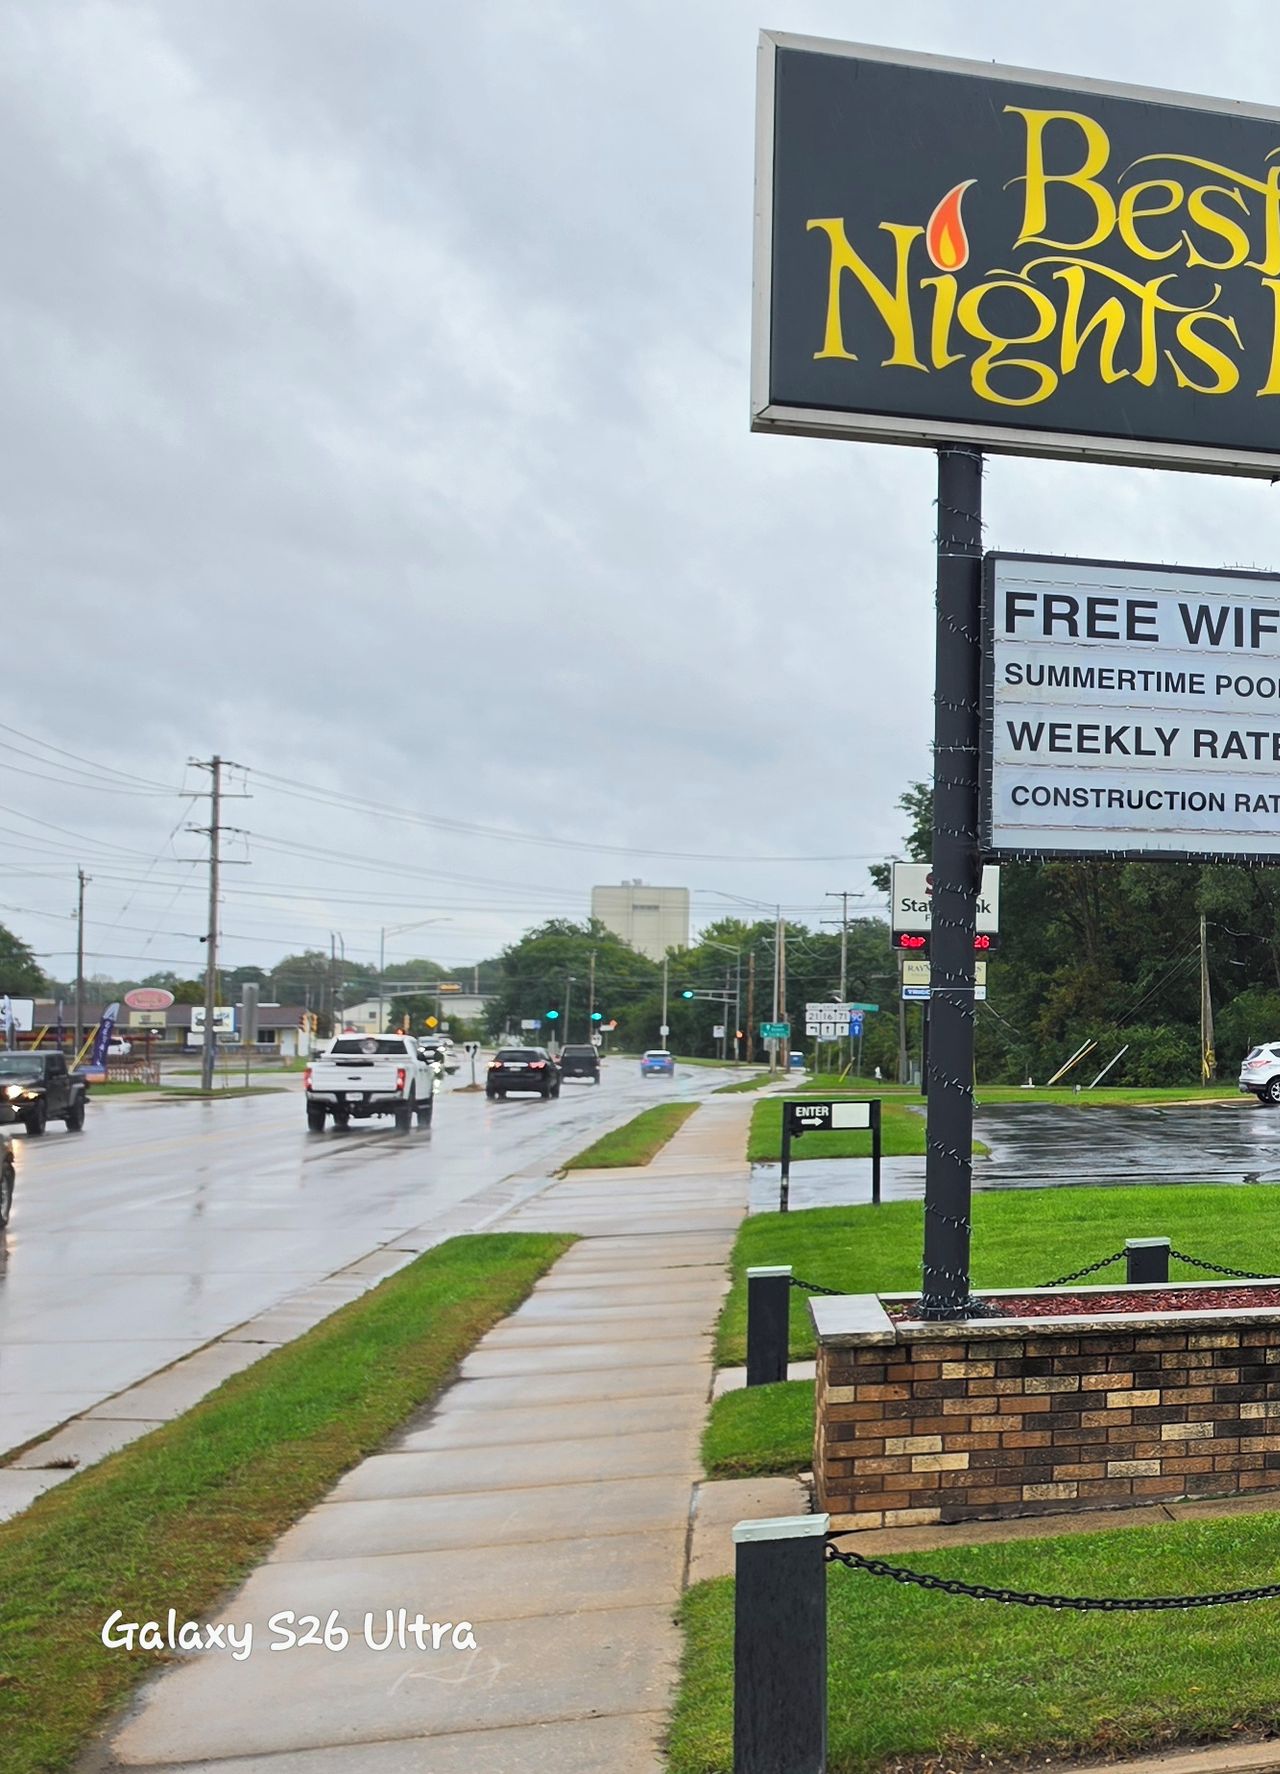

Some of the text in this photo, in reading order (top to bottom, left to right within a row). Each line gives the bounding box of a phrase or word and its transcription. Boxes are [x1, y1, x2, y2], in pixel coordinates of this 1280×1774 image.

[806, 215, 1245, 407] Nights
[1004, 590, 1160, 643] FREE
[1004, 662, 1206, 696] SUMMERTIME
[1006, 720, 1180, 757] WEEKLY
[1010, 784, 1226, 813] CONSTRUCTION
[795, 1105, 830, 1117] ENTER
